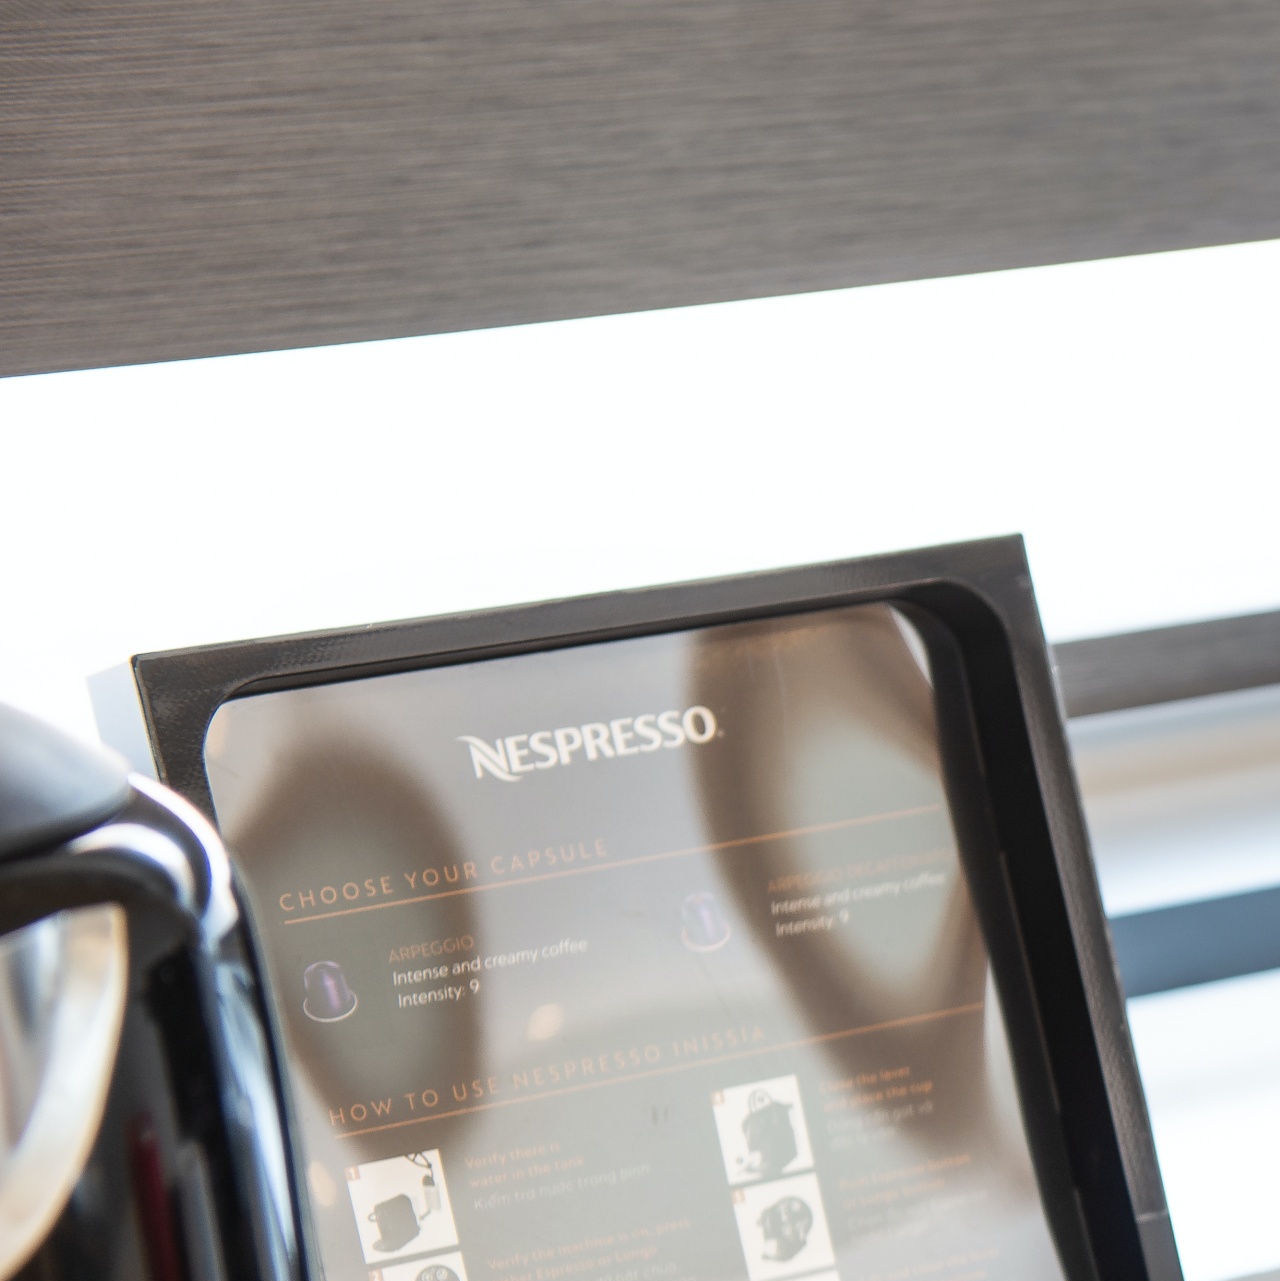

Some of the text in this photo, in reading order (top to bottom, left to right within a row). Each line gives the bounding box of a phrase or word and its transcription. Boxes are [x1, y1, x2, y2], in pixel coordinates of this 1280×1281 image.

[456, 704, 717, 782] NESPRESSO
[279, 839, 608, 913] CHOOSE YOUR CAPSULE
[393, 938, 588, 987] Intense and creamy coffee
[469, 979, 481, 995] 9
[329, 1024, 765, 1126] HOW TO USE NESPRESSO INISSIA
